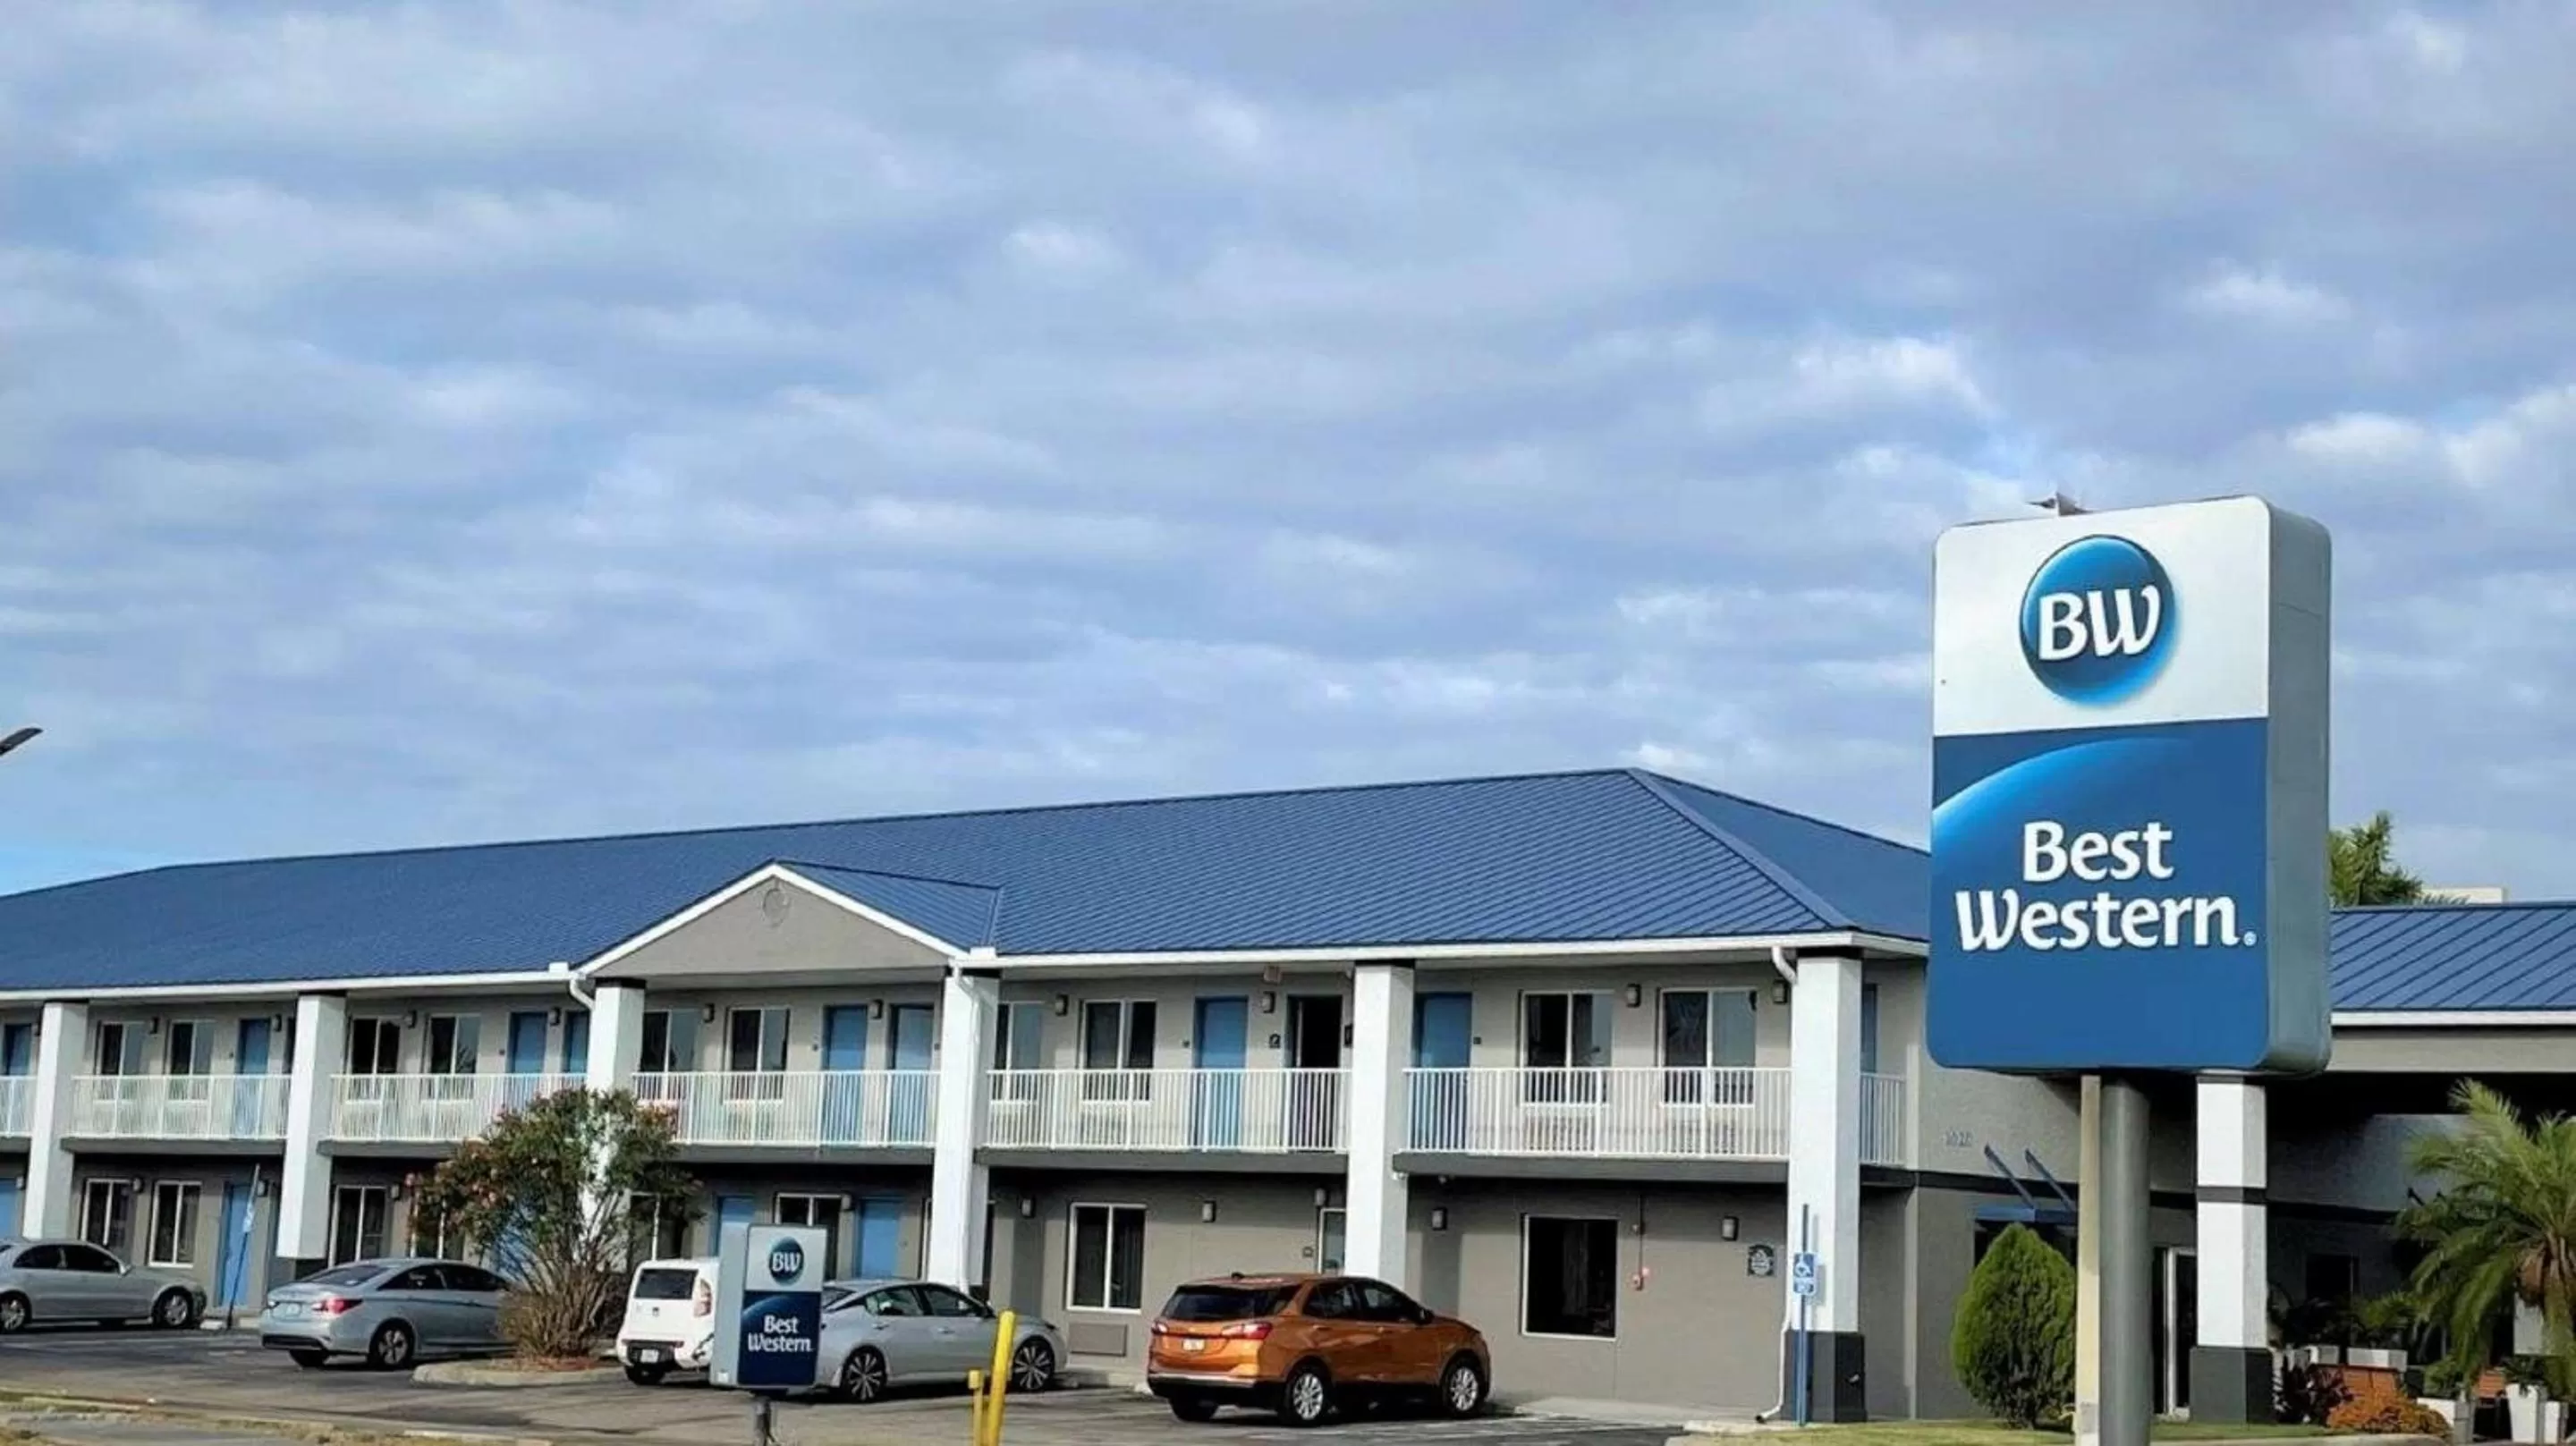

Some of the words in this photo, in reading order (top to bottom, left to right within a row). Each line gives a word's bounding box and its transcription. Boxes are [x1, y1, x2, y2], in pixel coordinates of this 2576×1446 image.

[2038, 584, 2160, 660] BW
[2023, 821, 2174, 882] Best
[771, 1252, 801, 1272] BW
[763, 1315, 798, 1333] Best
[748, 1333, 811, 1352] Western
